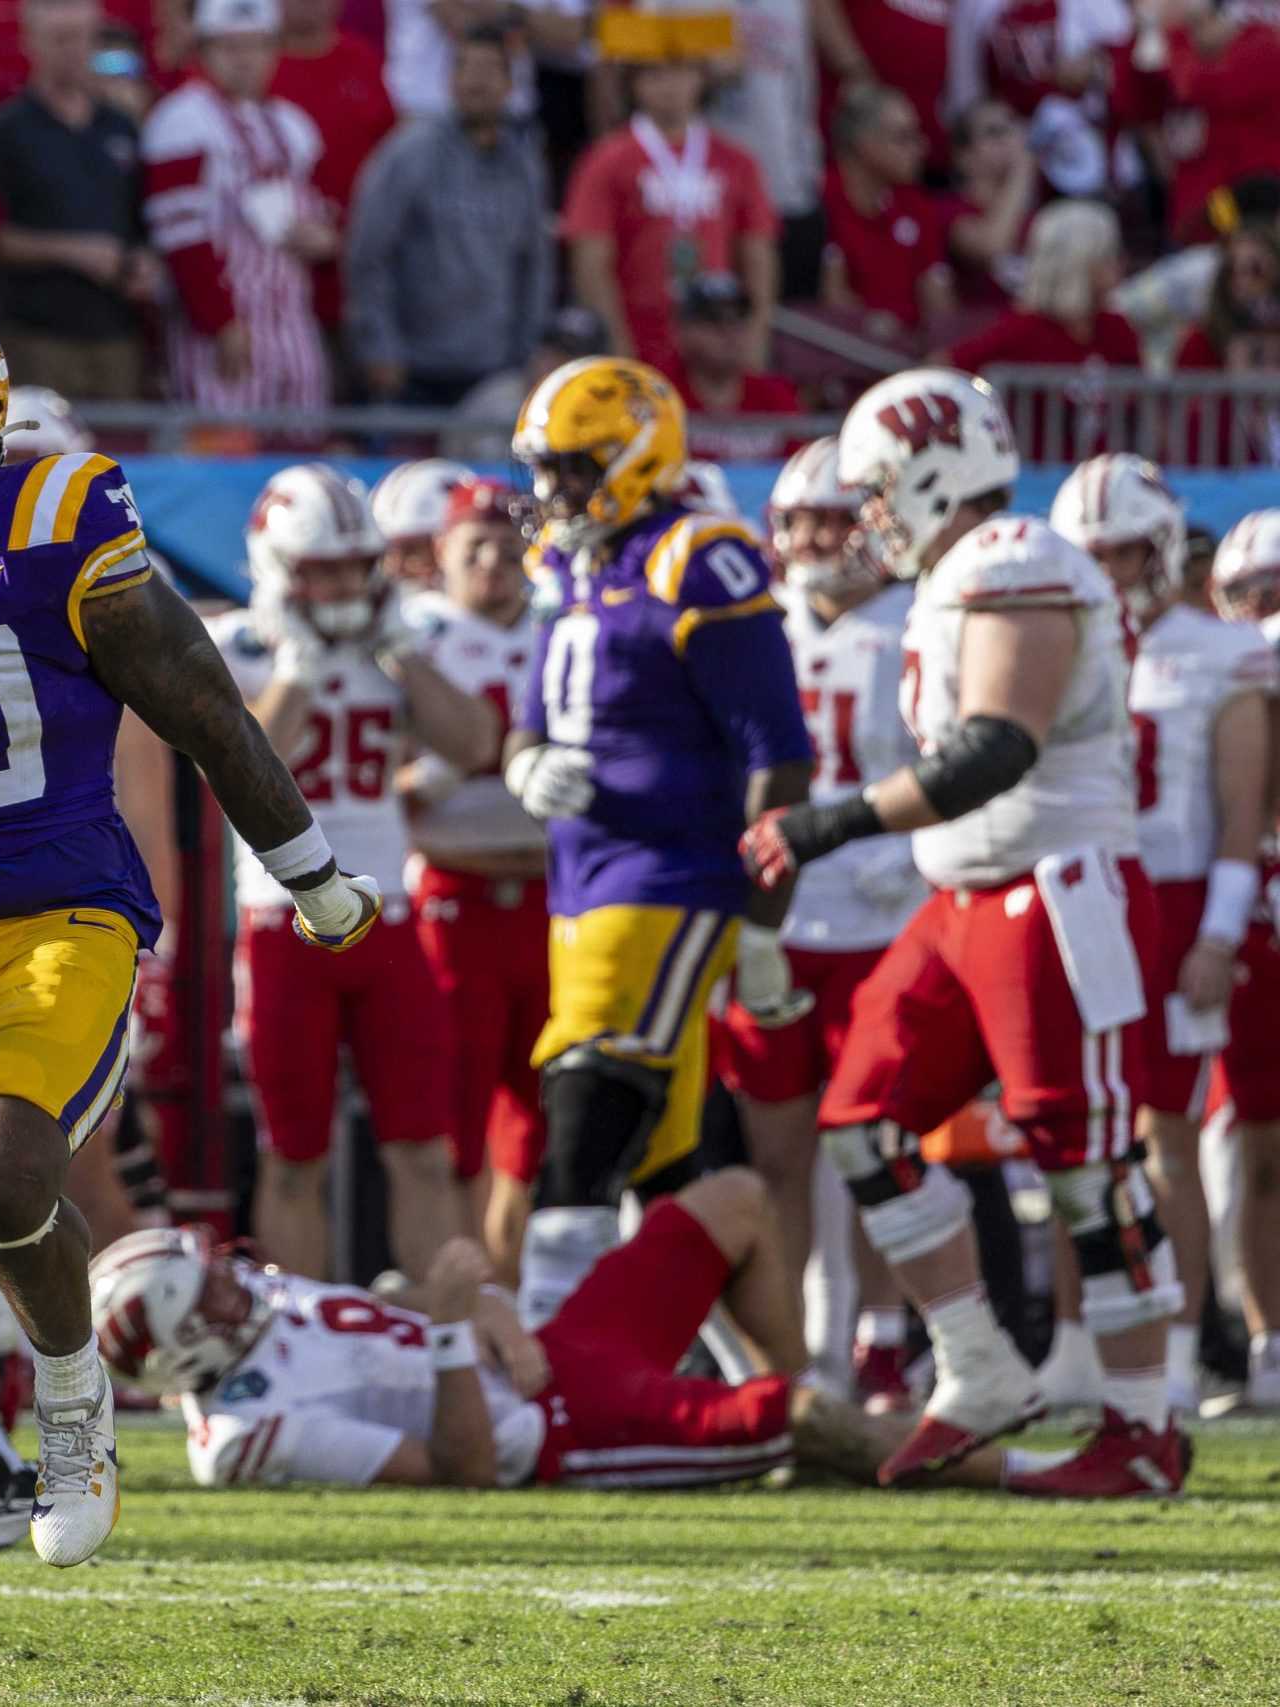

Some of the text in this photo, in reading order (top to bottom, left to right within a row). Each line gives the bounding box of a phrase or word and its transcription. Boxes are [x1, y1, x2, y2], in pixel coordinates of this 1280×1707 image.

[877, 392, 962, 455] W
[706, 541, 759, 600] 0
[544, 614, 599, 744] 0
